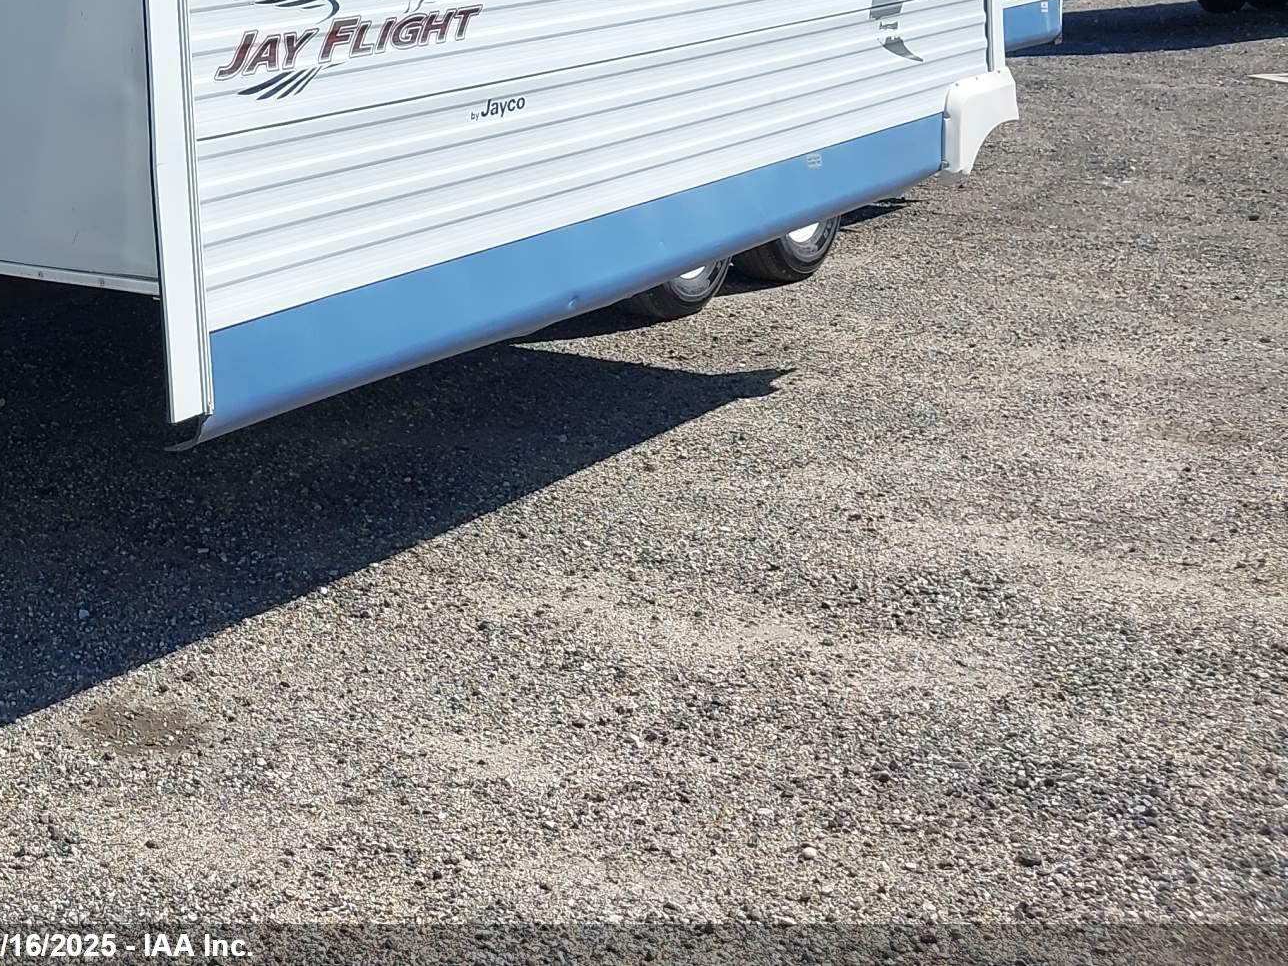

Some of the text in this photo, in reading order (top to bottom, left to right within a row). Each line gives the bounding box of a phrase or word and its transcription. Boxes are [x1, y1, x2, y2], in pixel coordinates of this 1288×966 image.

[214, 4, 483, 81] JAY FLIGHT
[470, 95, 526, 122] by Jayco
